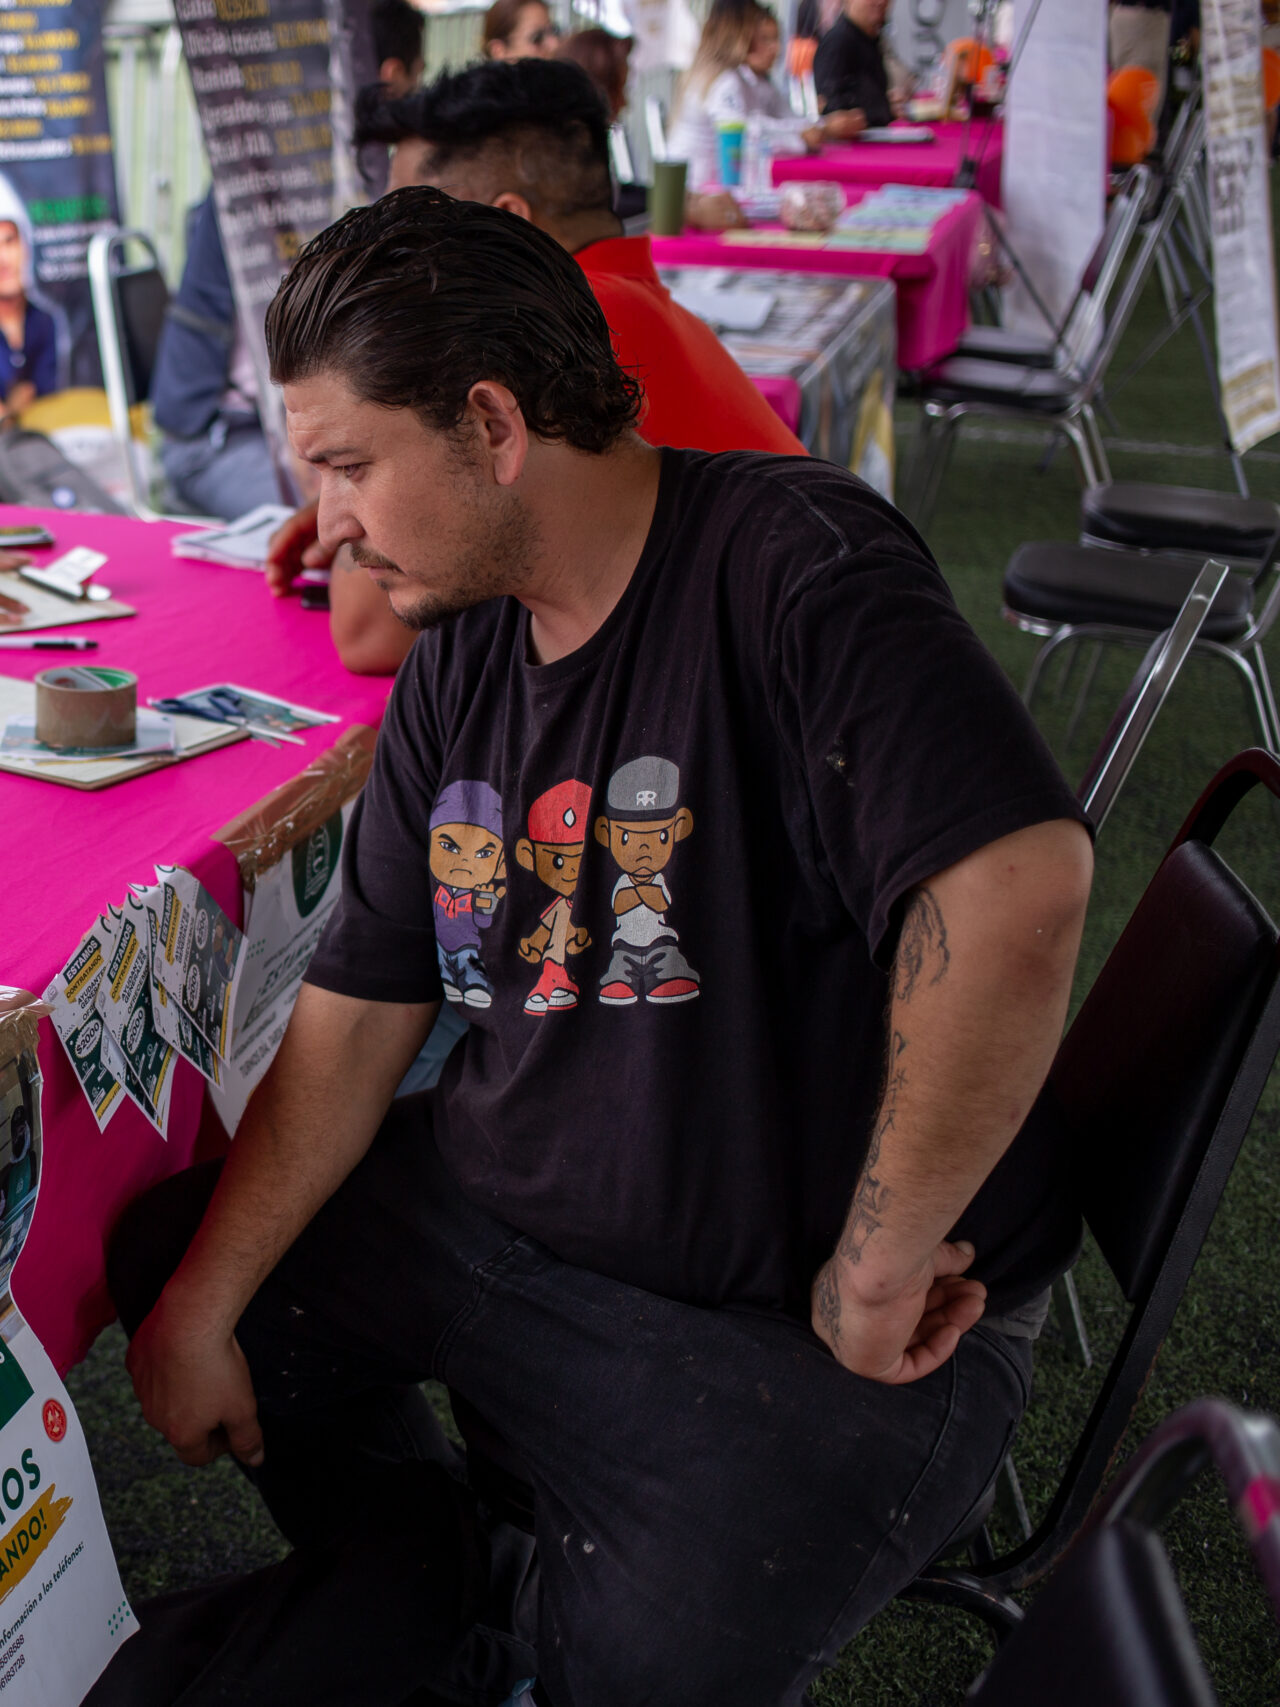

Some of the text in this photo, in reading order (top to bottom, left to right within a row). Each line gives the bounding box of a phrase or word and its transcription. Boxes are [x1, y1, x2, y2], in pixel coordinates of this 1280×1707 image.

[162, 885, 173, 943] ESTAMOS
[66, 940, 99, 981] ESTAMOS
[109, 923, 133, 979] ESTAMOS
[111, 938, 137, 999] CONTRATANDO
[66, 954, 101, 999] CONTRATANDO
[76, 1022, 100, 1055] $2000
[126, 1008, 144, 1052] $2000
[43, 1579, 53, 1596] los
[53, 1541, 85, 1584] teléfonos:
